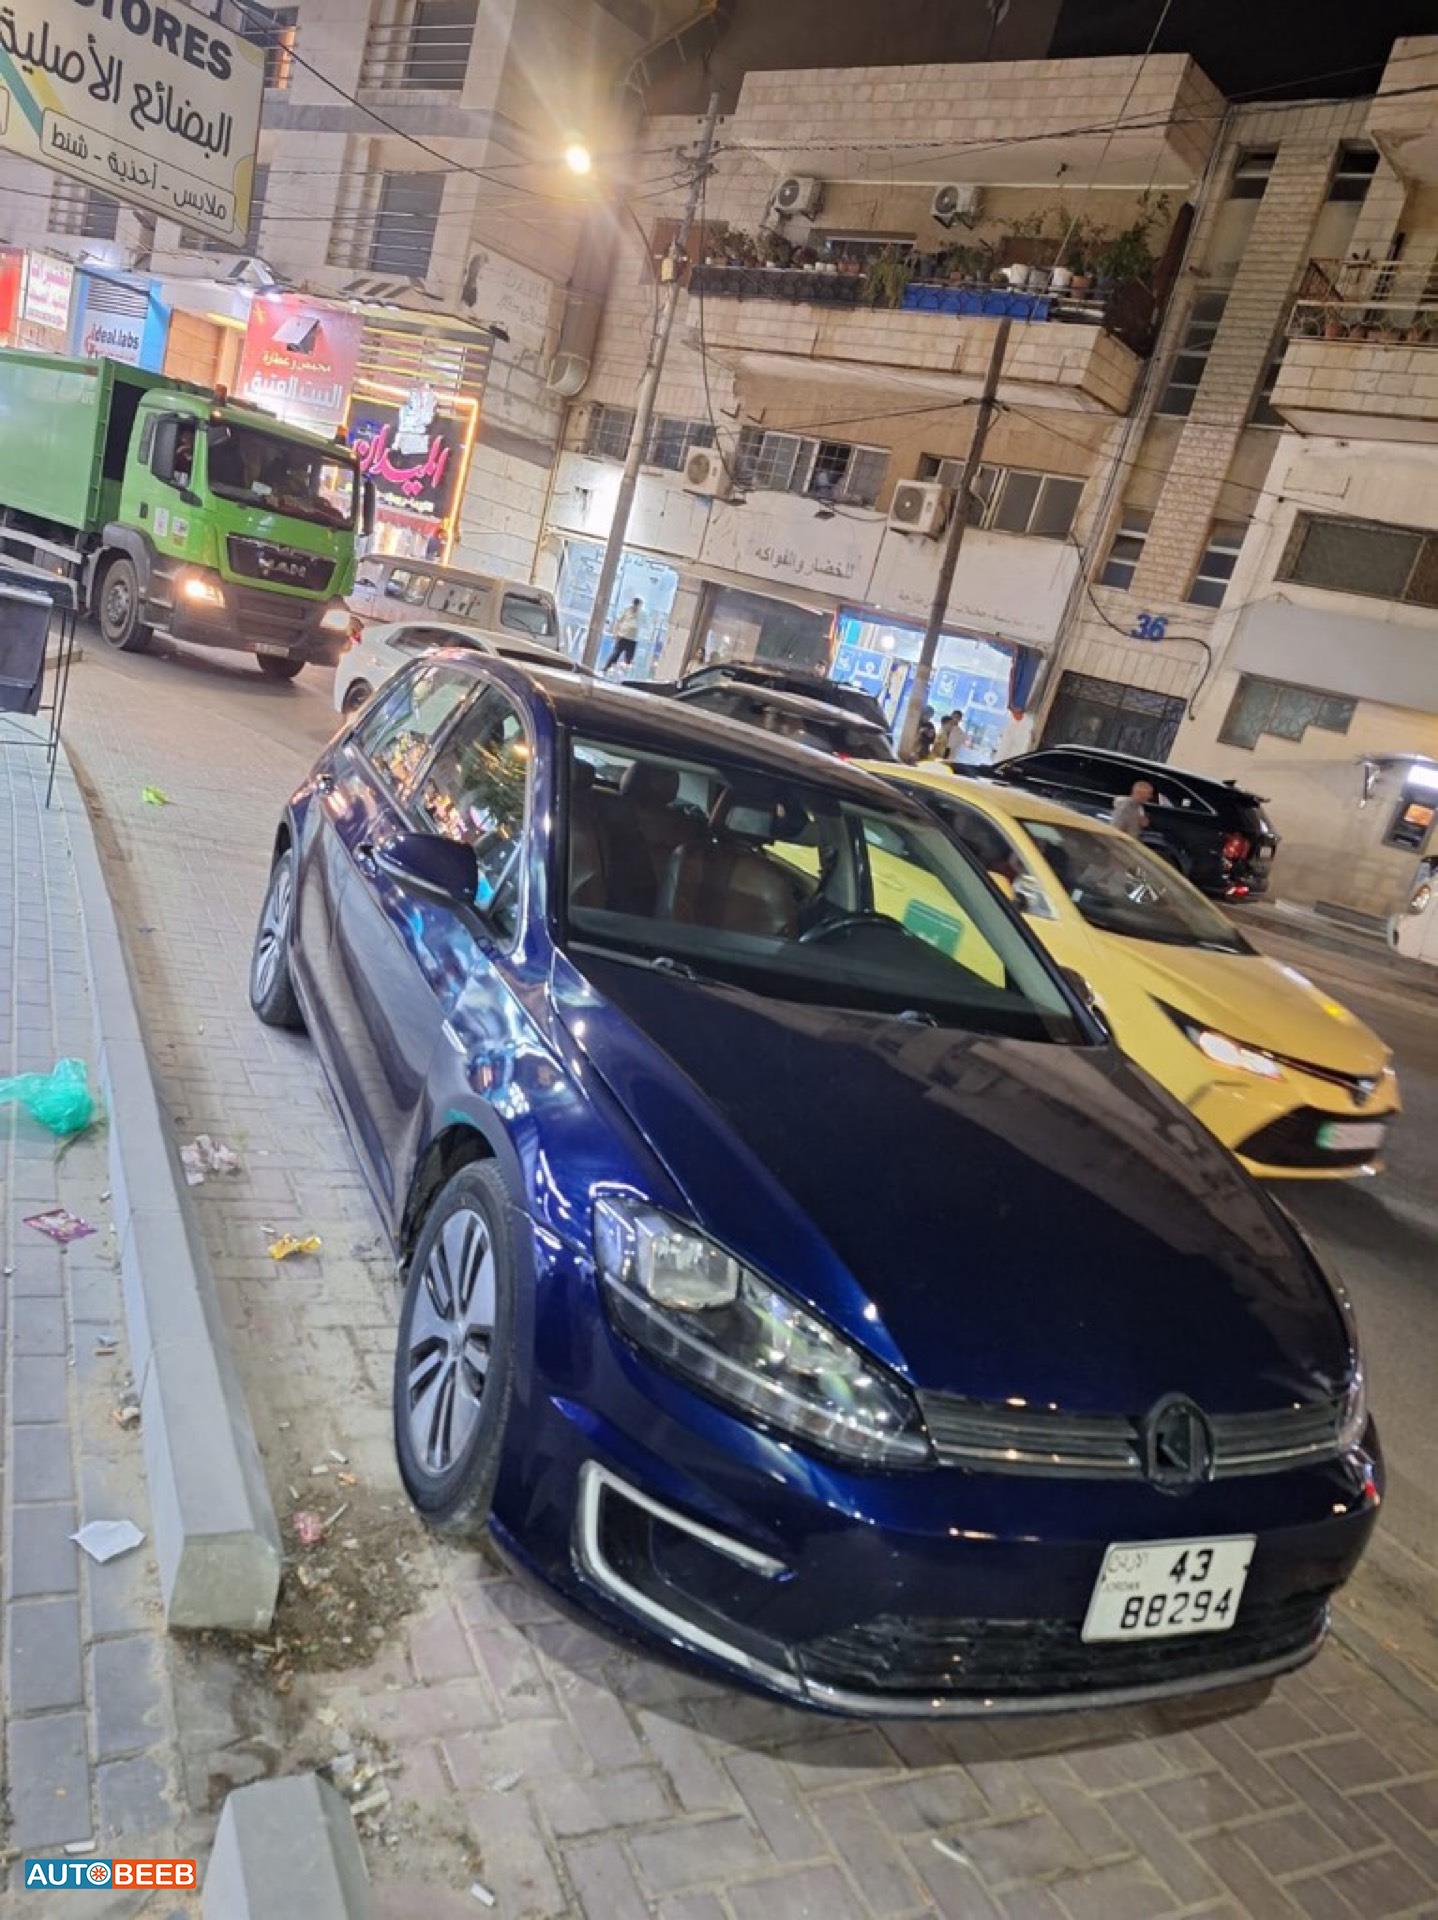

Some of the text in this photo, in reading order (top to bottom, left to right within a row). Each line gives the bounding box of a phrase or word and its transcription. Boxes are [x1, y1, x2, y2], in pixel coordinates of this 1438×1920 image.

[74, 0, 233, 80] ORES
[0, 6, 233, 159] البضائع الأصلية
[51, 122, 89, 159] شنط
[173, 189, 227, 220] ملابس
[1131, 613, 1168, 641] 36
[1169, 1548, 1213, 1584] 43
[1120, 1588, 1233, 1629] 88294
